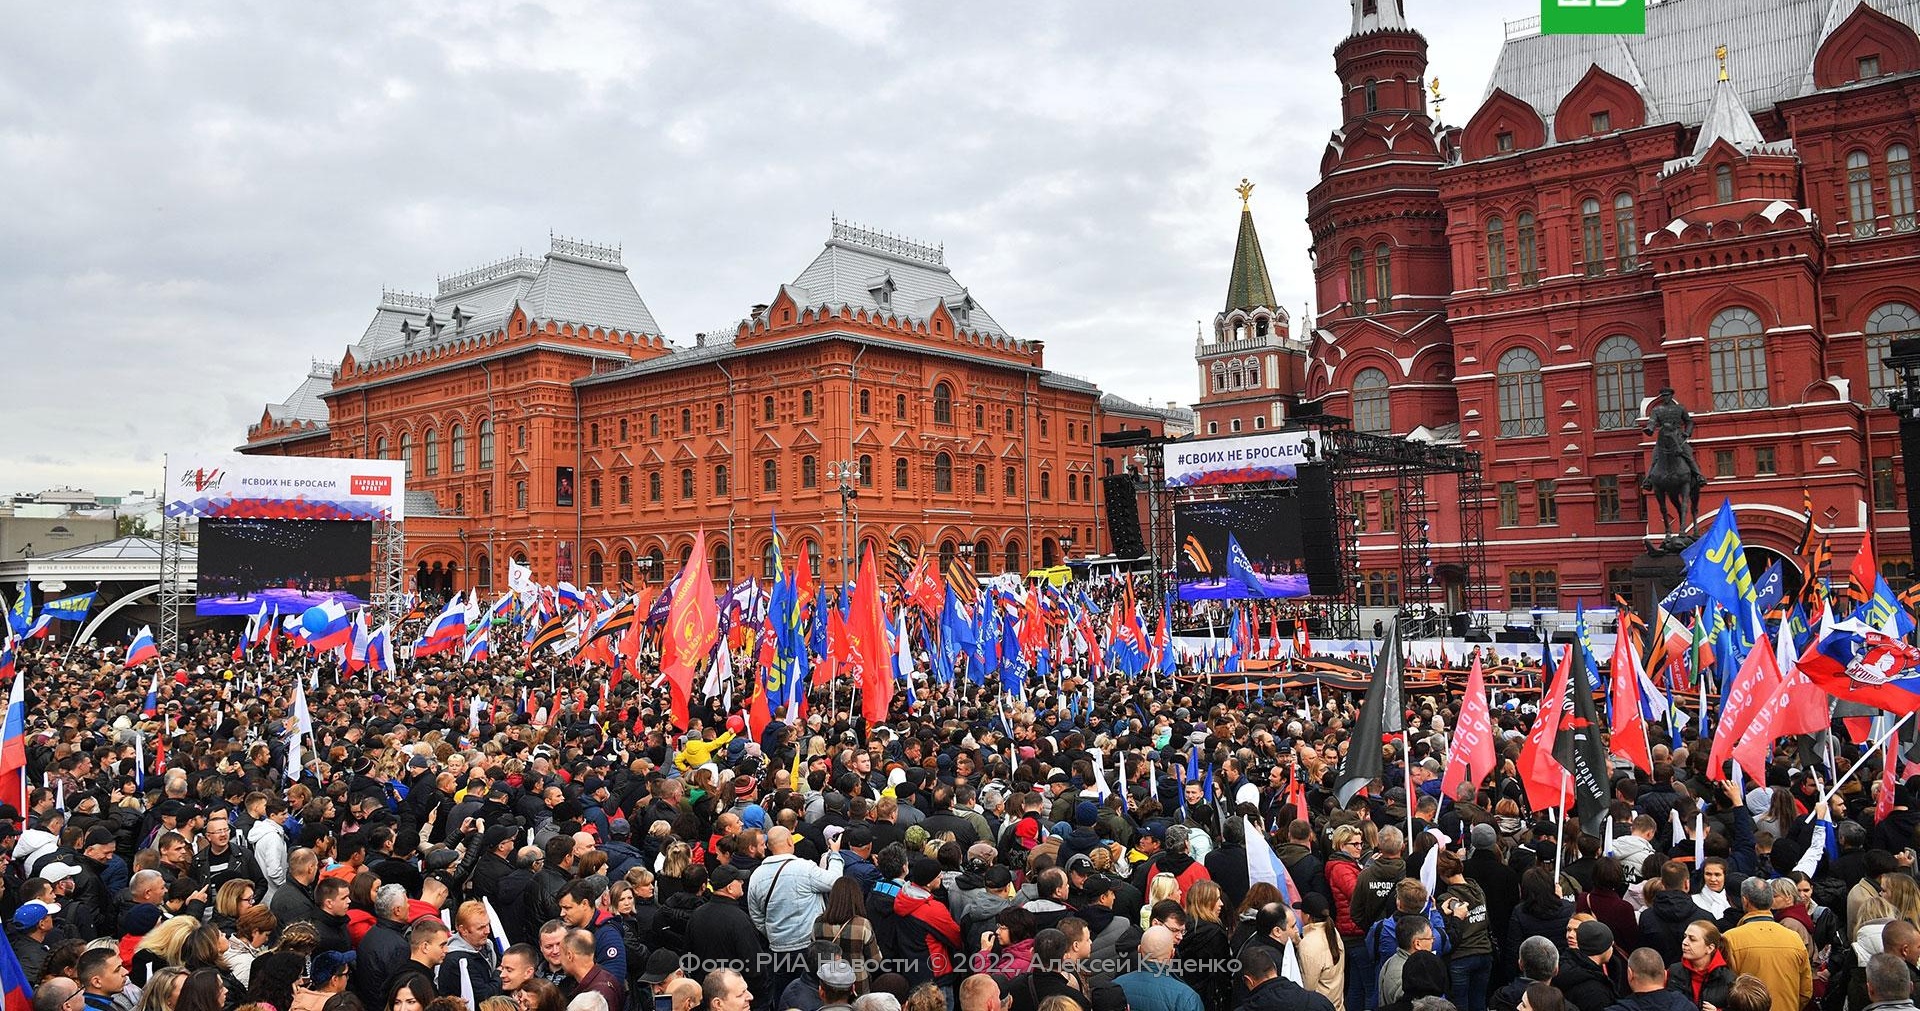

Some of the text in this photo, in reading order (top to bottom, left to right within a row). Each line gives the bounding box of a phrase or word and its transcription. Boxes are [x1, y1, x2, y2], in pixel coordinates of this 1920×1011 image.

[1177, 443, 1305, 466] #СВОИХ НЕ БРОСАЕМ
[241, 477, 337, 489] #СВОИХ НЕ БРОСАЕМ
